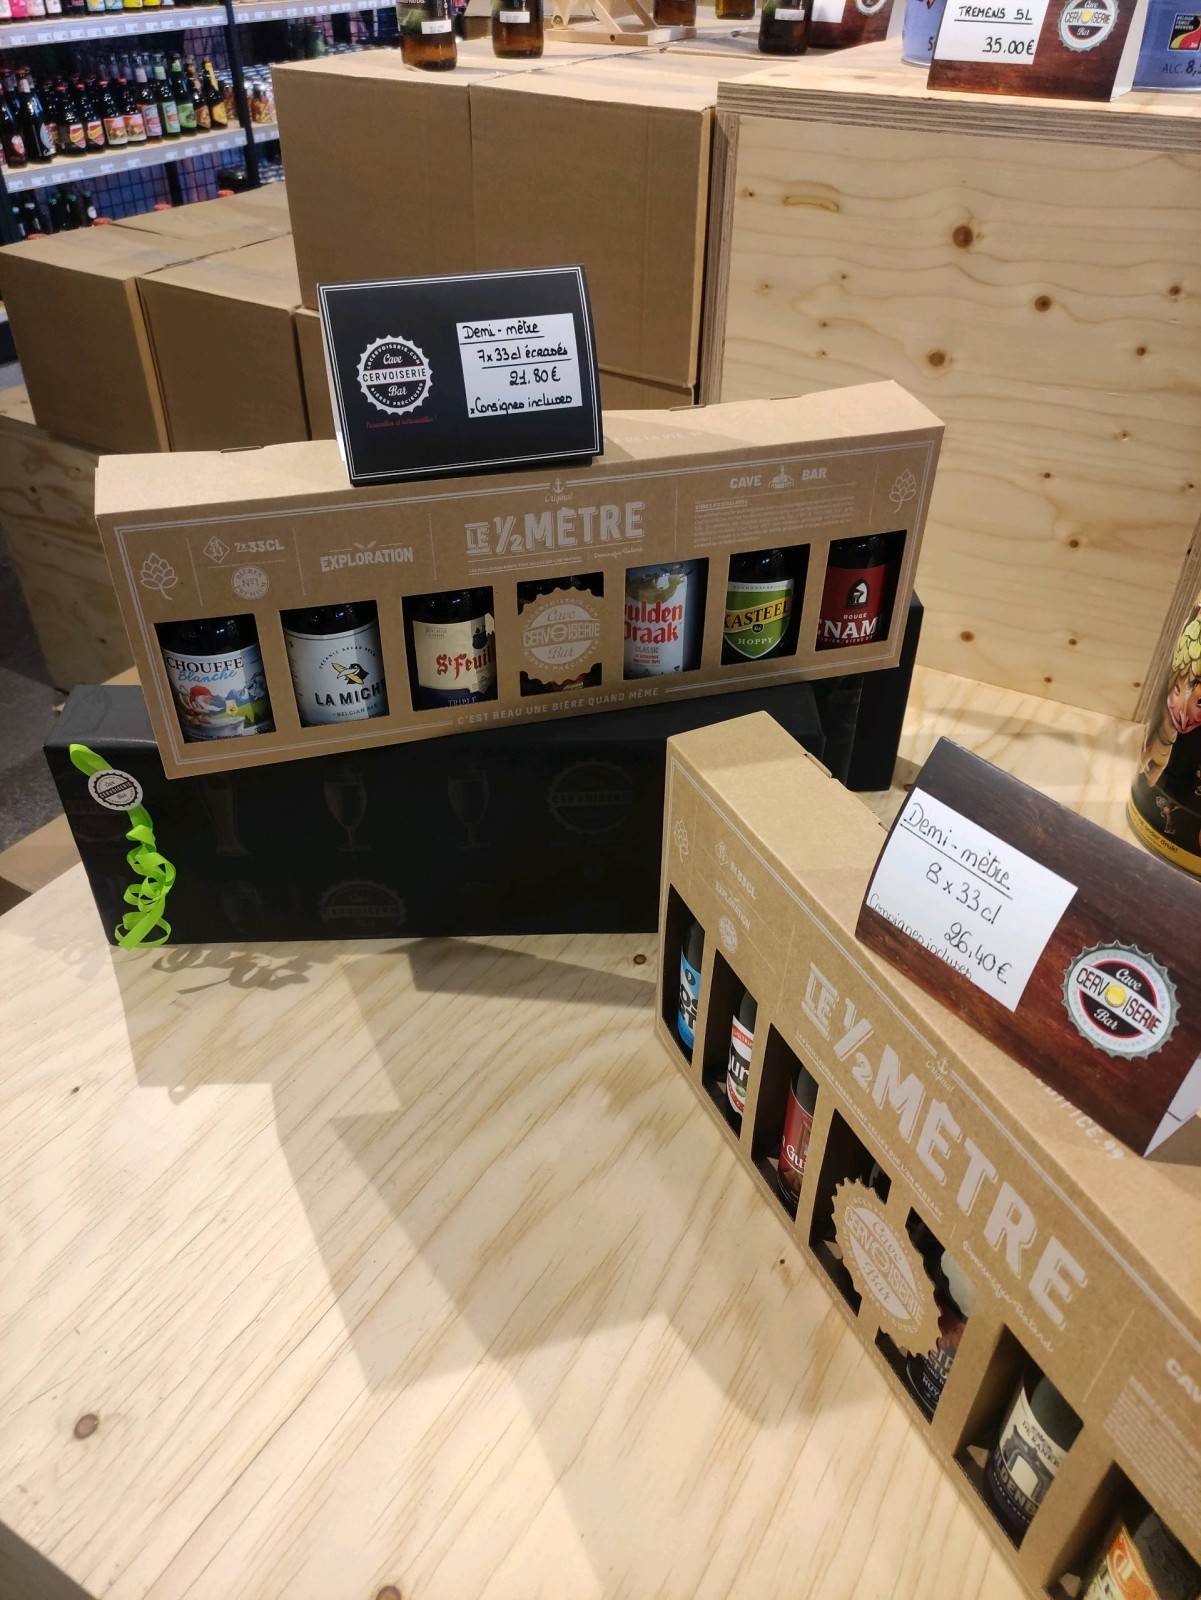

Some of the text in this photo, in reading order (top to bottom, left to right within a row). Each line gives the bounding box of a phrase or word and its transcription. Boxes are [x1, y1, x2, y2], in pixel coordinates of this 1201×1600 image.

[958, 6, 1032, 20] TREMENS 5L
[383, 354, 402, 364] Cave
[362, 368, 426, 382] CERVOISERIE
[388, 385, 408, 396] Bar
[730, 468, 827, 488] CAVE BAR
[320, 547, 414, 572] EXPLORATION
[548, 610, 576, 622] Cave
[724, 600, 790, 628] KASTEEL
[522, 622, 600, 647] CERVOISERIE
[738, 637, 774, 646] HOPPY
[548, 646, 574, 660] Bar
[166, 656, 244, 674] CHOUFFE
[178, 668, 238, 682] Blanche
[315, 692, 336, 706] LA
[336, 708, 366, 718] BELGIAN
[458, 712, 489, 725] C'EST
[493, 708, 522, 720] BEAU
[526, 704, 548, 716] UNE
[588, 693, 626, 708] QUAND
[1116, 968, 1142, 990] Cave
[1094, 1008, 1118, 1030] Bar
[868, 1122, 889, 1152] CELLES
[872, 1222, 904, 1266] Cave
[844, 1206, 924, 1326] CERVOISERIE
[862, 1261, 890, 1300] Bar
